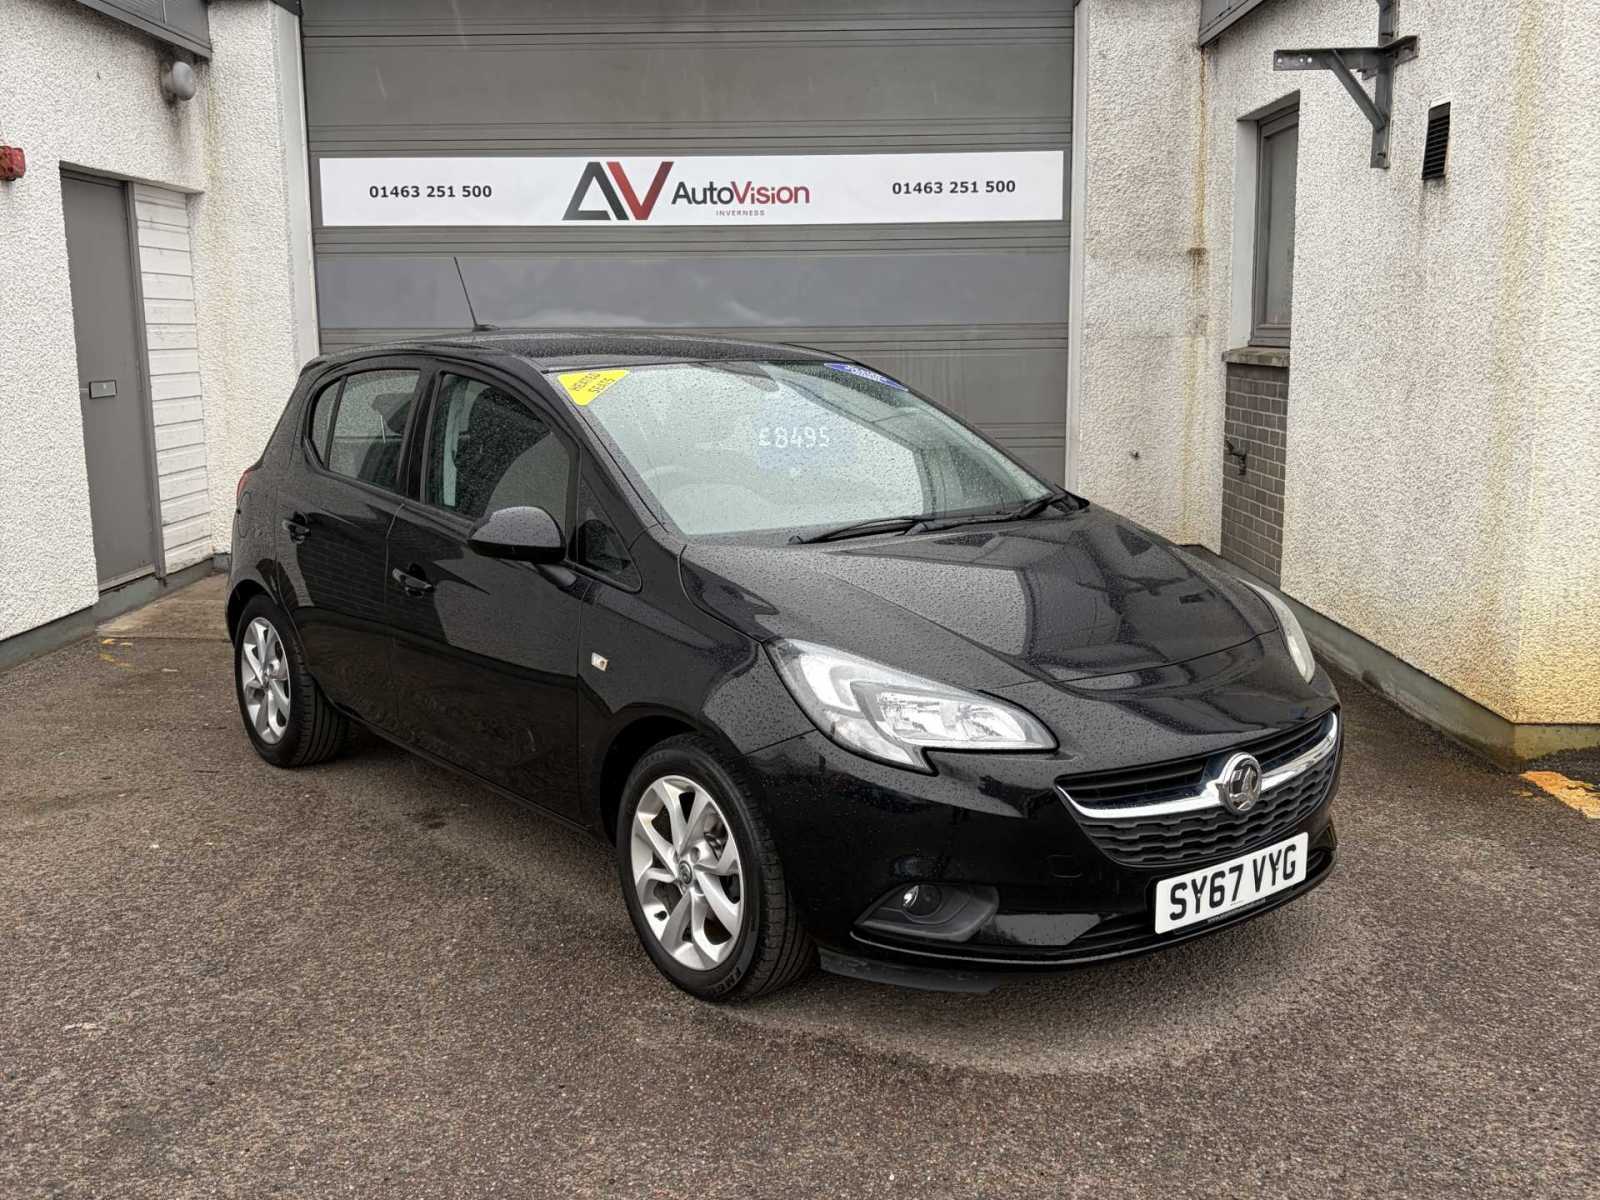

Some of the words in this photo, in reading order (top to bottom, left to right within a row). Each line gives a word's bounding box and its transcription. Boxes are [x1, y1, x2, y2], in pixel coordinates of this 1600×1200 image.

[369, 185, 420, 198] 01463
[426, 185, 456, 198] 251
[462, 185, 492, 198] 500
[671, 181, 810, 205] AutoVision
[892, 182, 943, 195] 01463
[949, 181, 979, 194] 251
[985, 180, 1016, 193] 500
[758, 426, 830, 448] £8495
[1169, 863, 1244, 921] SY67
[1253, 844, 1297, 893] VYG
